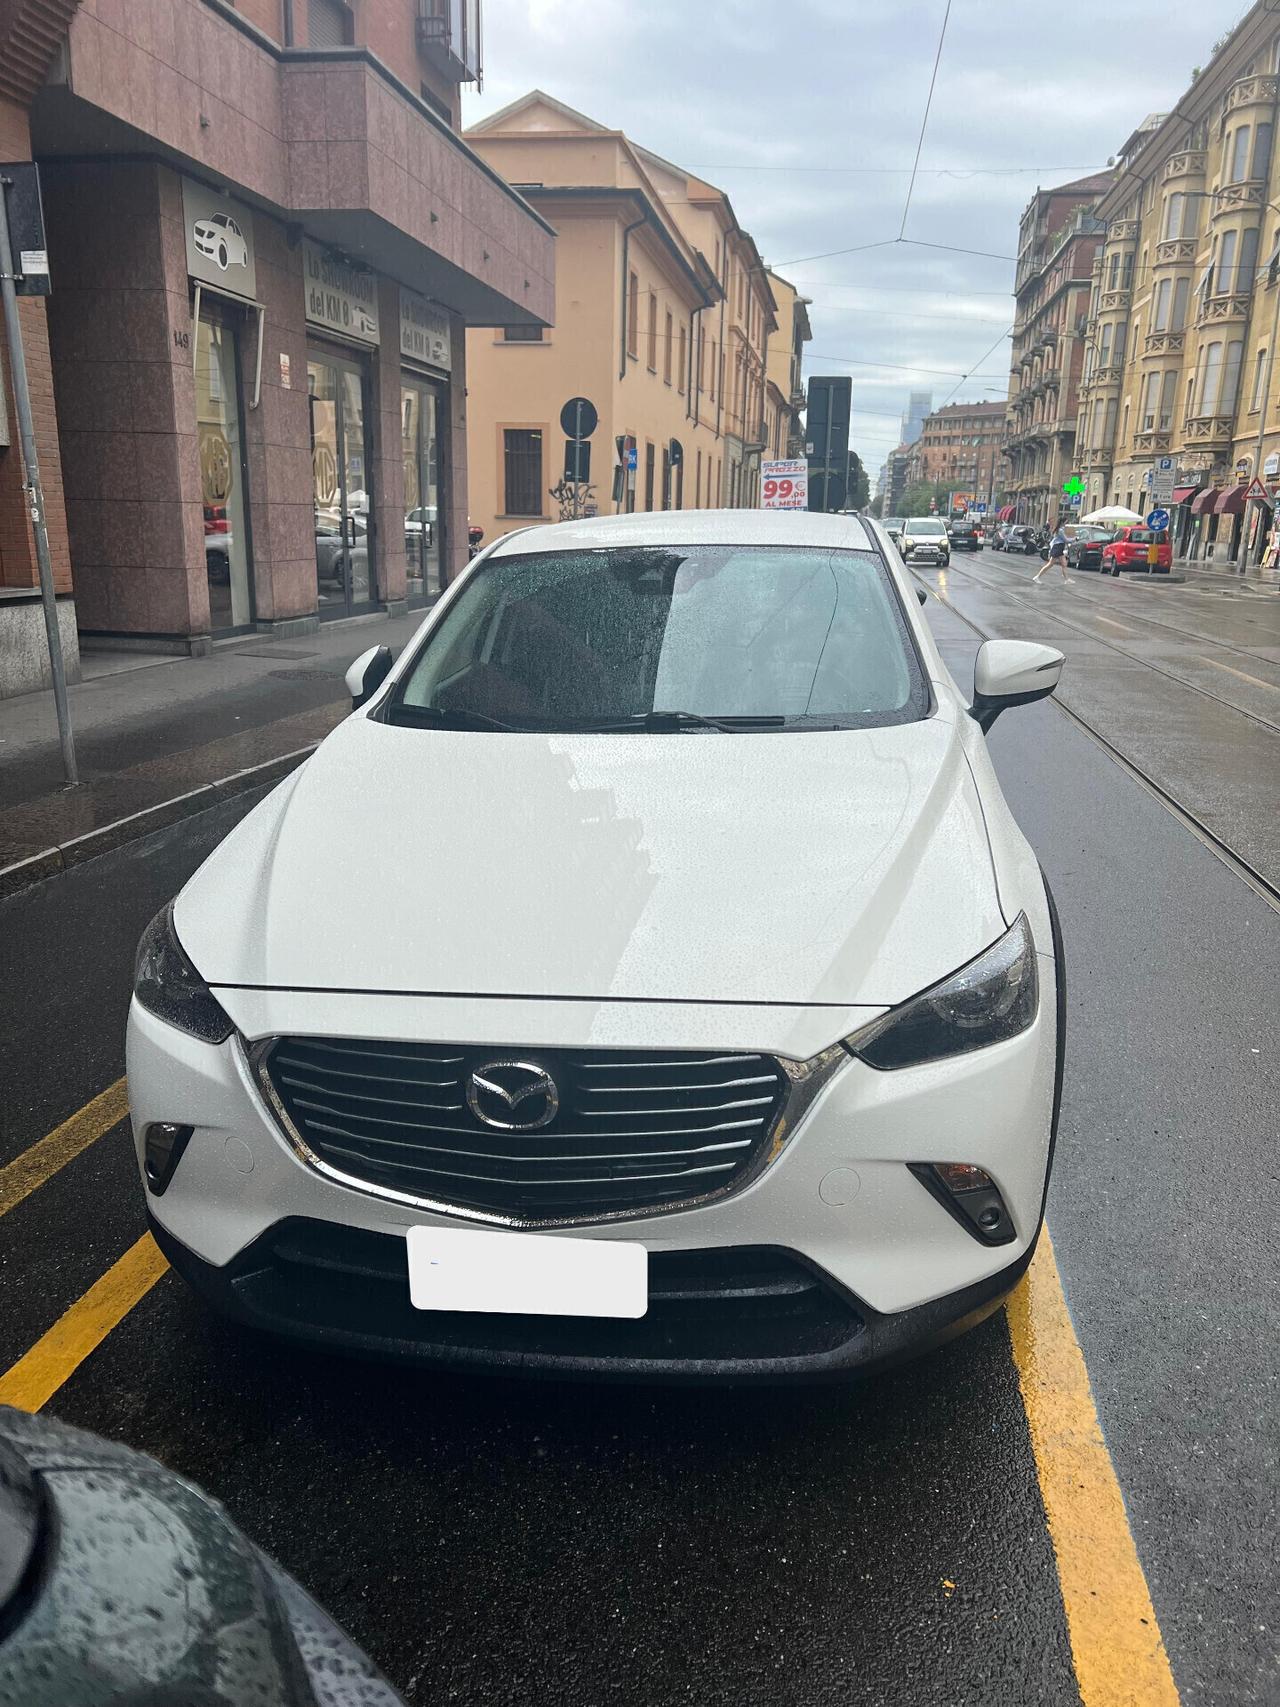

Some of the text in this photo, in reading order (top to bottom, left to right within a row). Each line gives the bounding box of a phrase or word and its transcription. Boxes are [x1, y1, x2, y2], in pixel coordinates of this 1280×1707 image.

[310, 287, 325, 318] del
[326, 292, 341, 323] KM
[173, 330, 189, 349] 149
[1161, 460, 1170, 469] P
